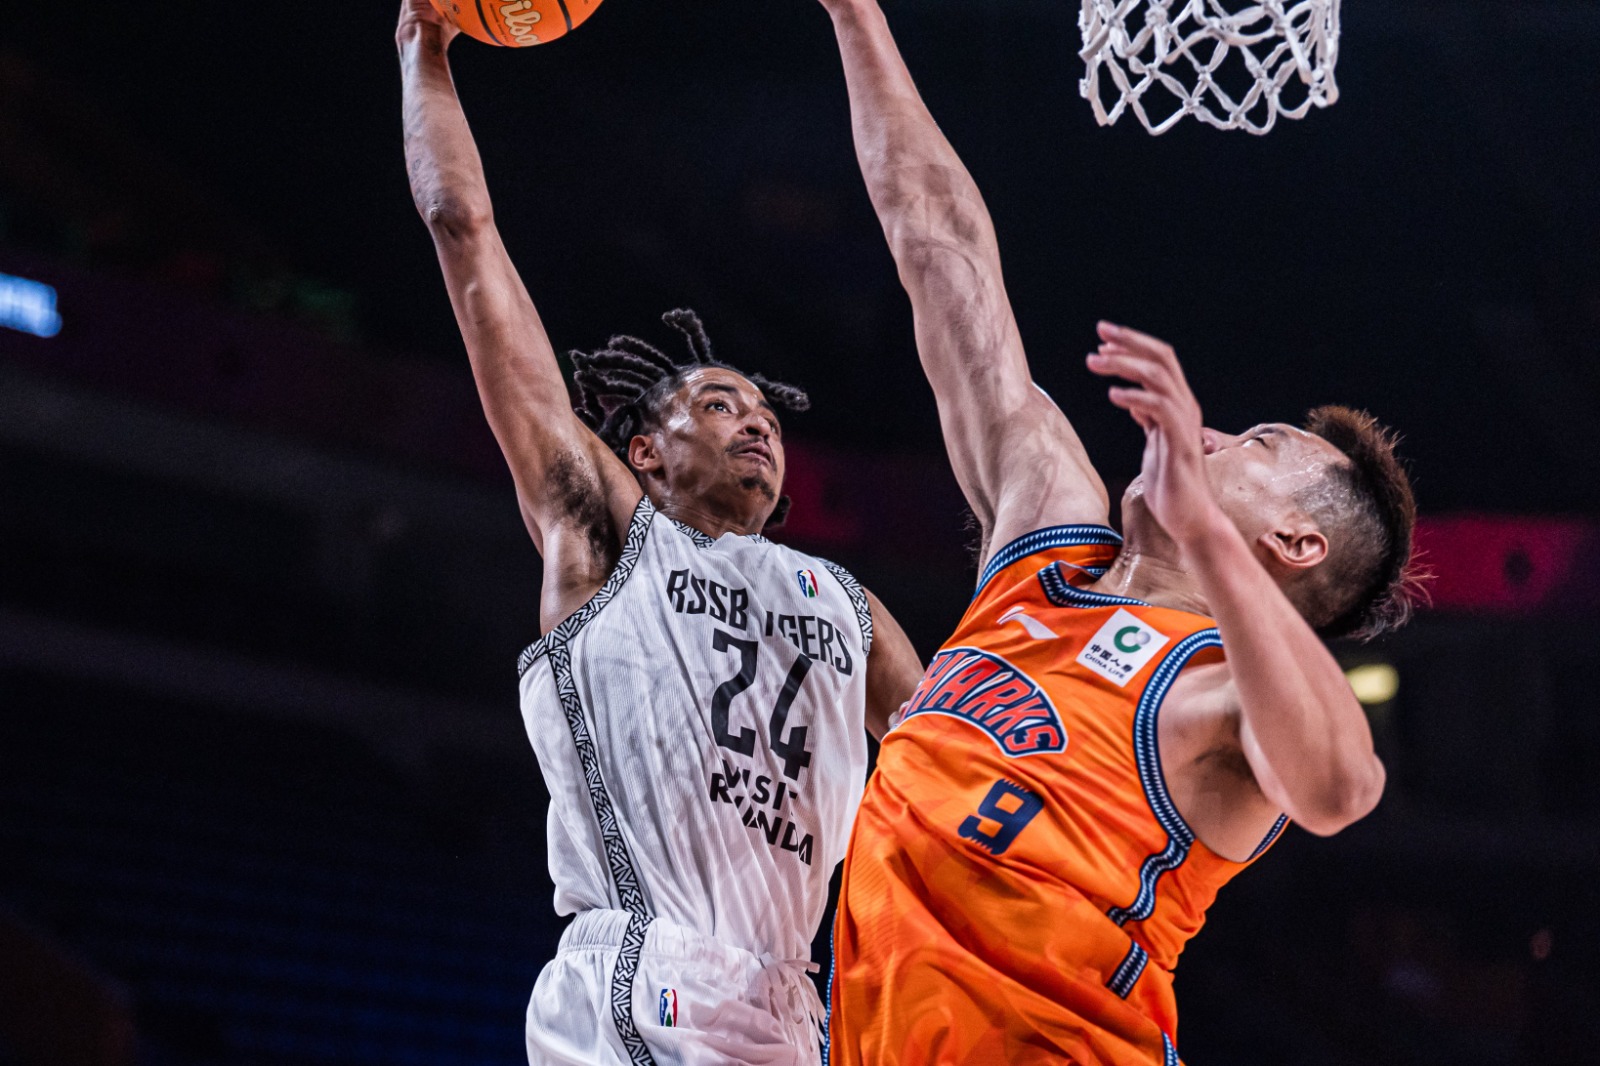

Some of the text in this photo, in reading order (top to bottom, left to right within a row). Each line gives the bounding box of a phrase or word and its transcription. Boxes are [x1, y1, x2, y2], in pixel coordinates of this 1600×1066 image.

[500, 0, 542, 47] ilso
[667, 568, 853, 676] RSSB IGERS
[1084, 653, 1107, 669] CHINA
[711, 628, 811, 780] 24
[897, 651, 1060, 751] HARKS
[709, 772, 813, 866] RANDA
[721, 759, 798, 810] VISI
[957, 778, 1045, 855] 9
